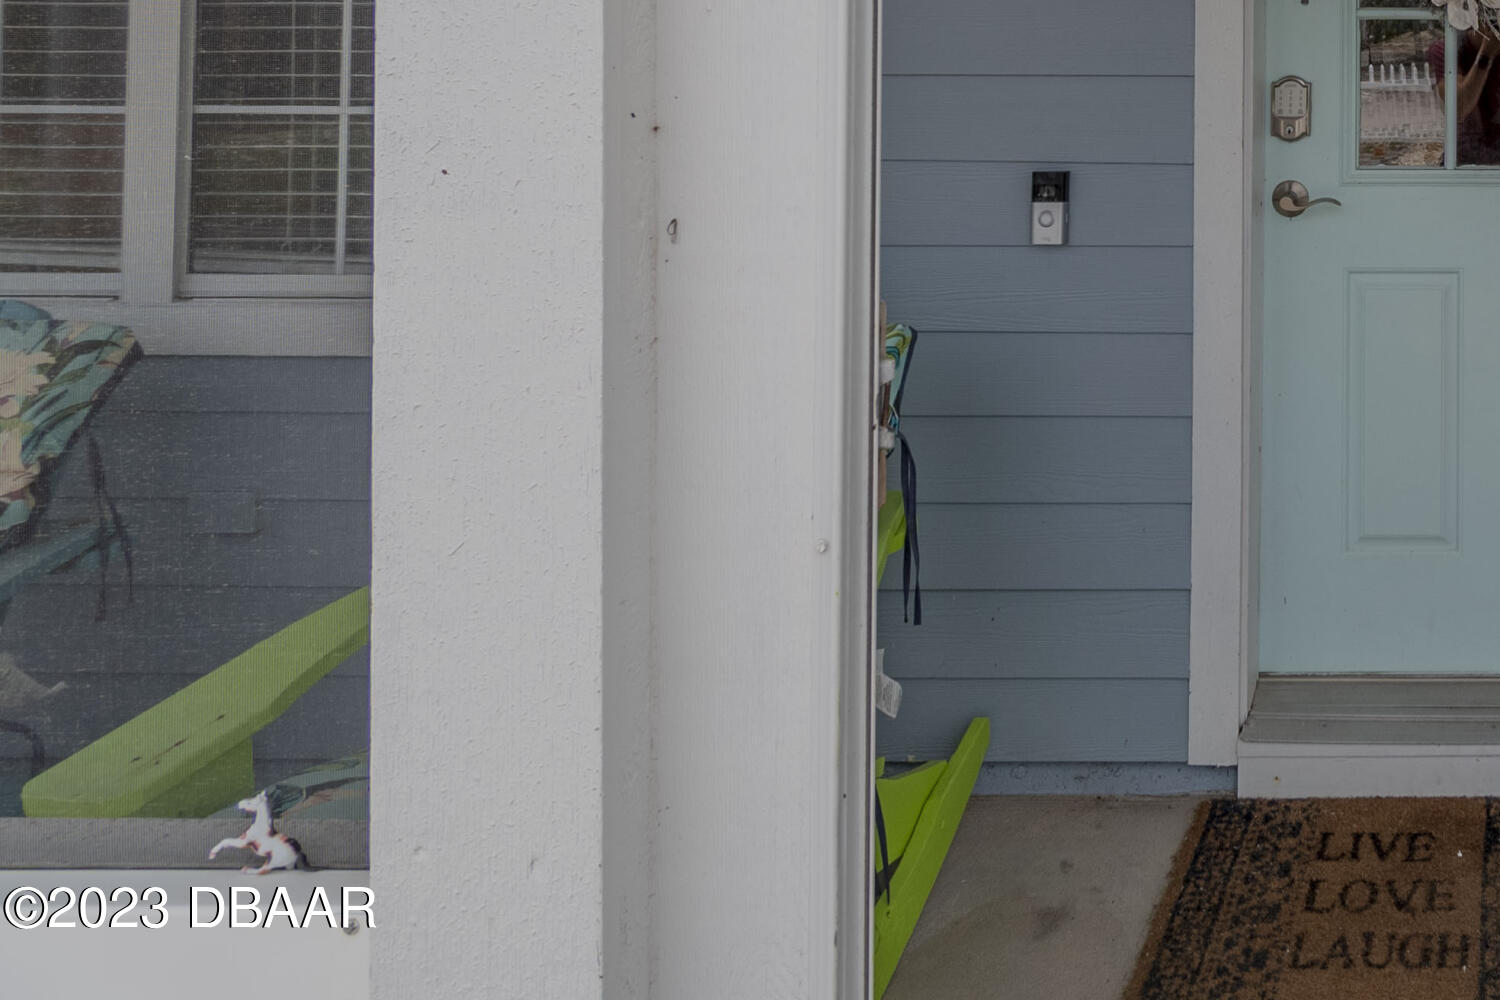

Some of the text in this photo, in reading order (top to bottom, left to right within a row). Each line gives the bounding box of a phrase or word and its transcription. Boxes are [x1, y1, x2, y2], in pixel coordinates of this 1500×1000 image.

[1315, 831, 1437, 863] LIVE
[1304, 878, 1457, 914] LOVE
[1289, 931, 1470, 970] LAUGH
